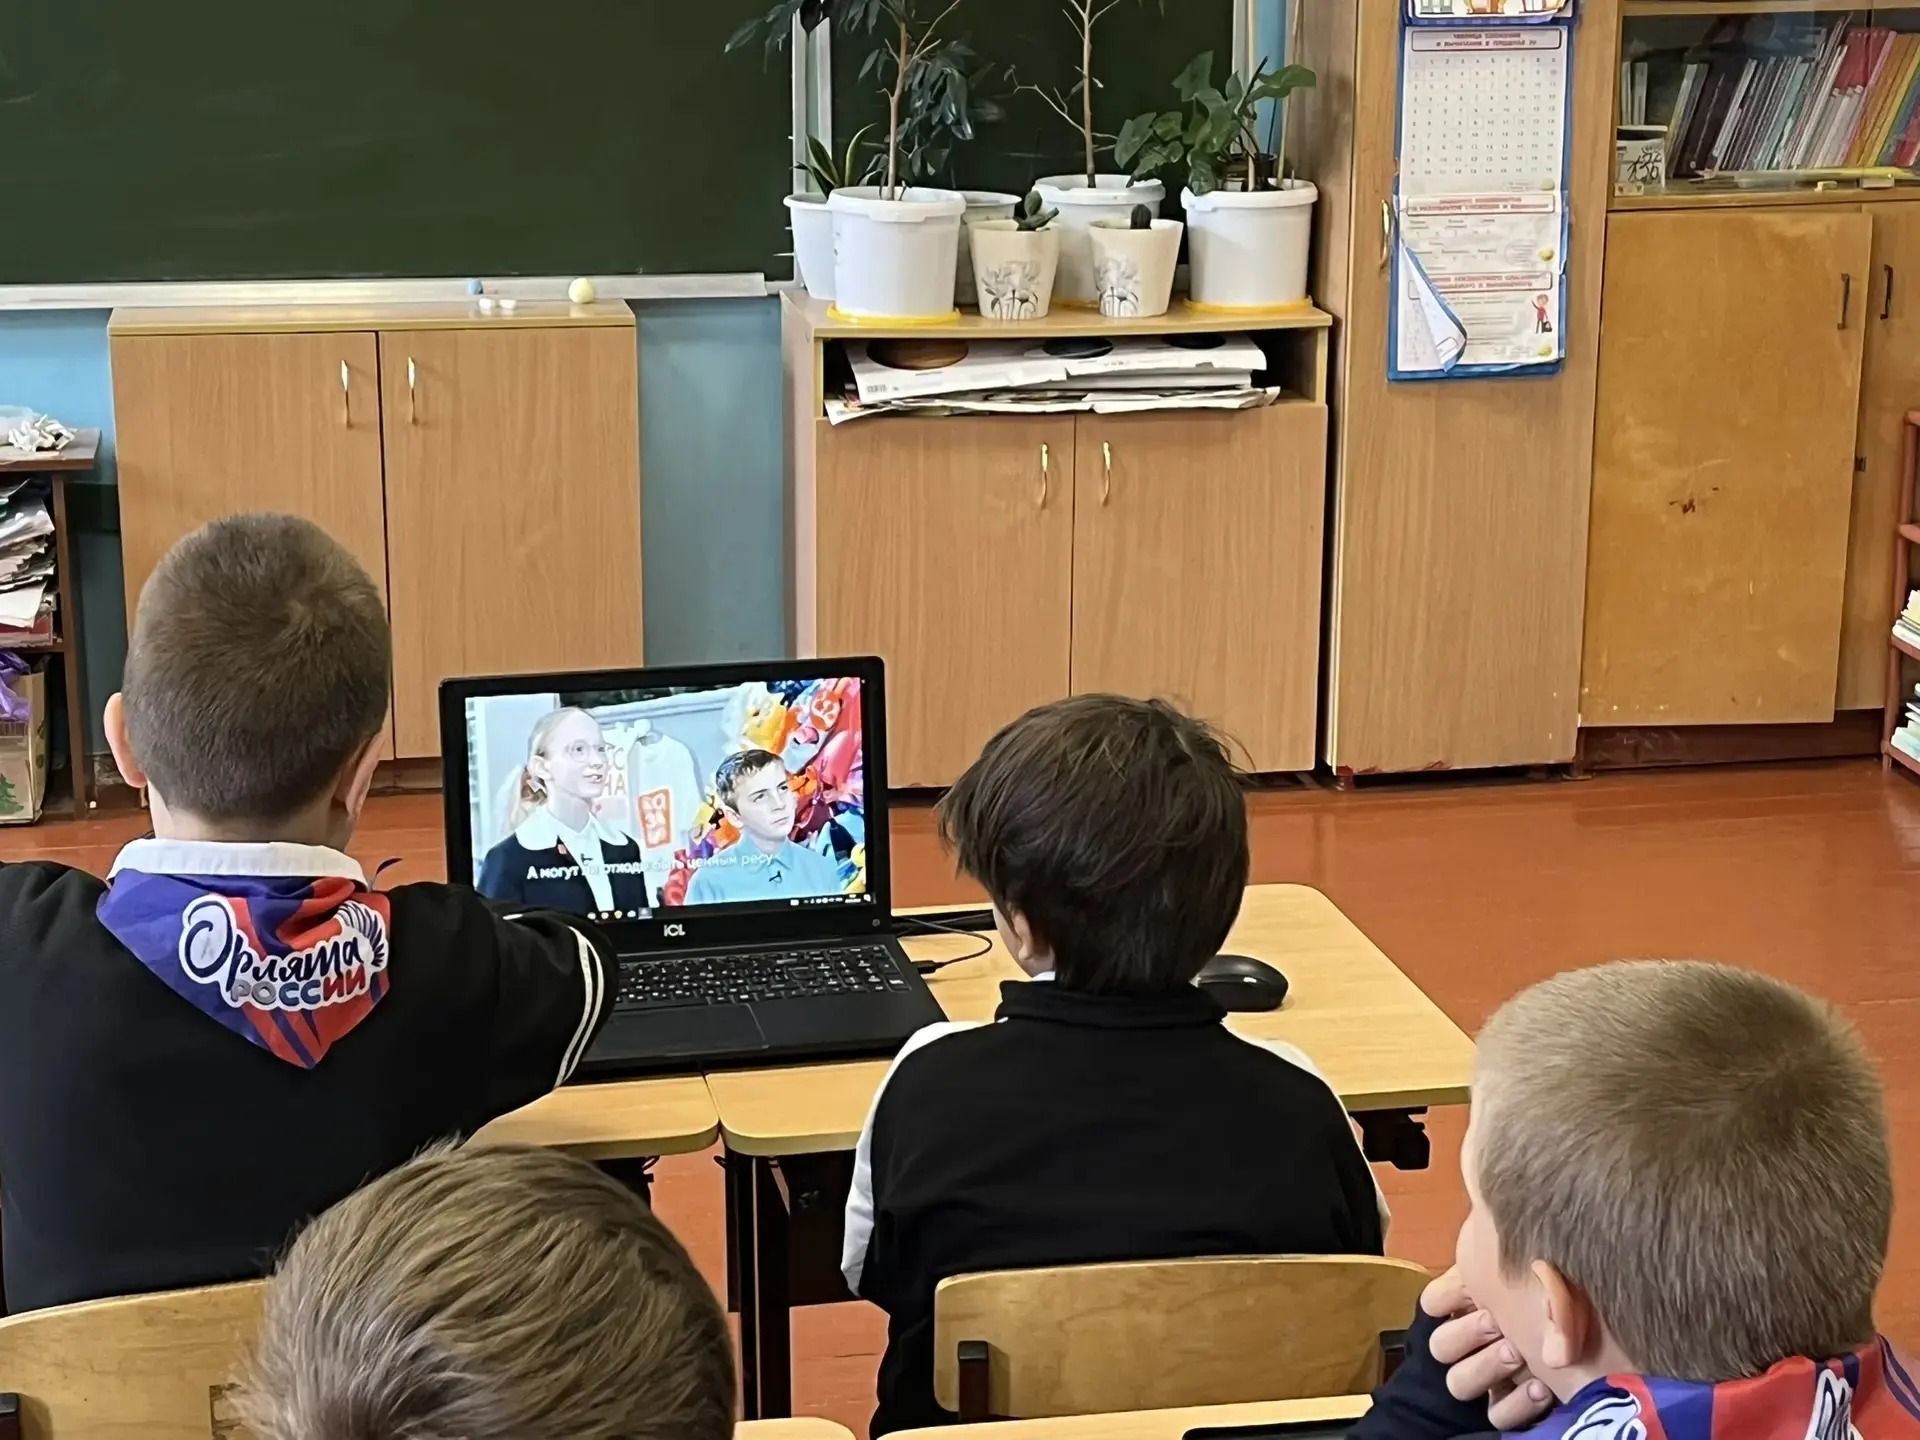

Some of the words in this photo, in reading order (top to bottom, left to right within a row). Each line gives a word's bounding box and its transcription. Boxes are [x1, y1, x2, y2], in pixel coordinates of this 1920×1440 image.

[526, 865, 539, 880] А
[539, 865, 580, 880] могут
[688, 856, 738, 870] ценным
[184, 900, 365, 992] Орлята
[230, 963, 367, 1007] РОССИИ
